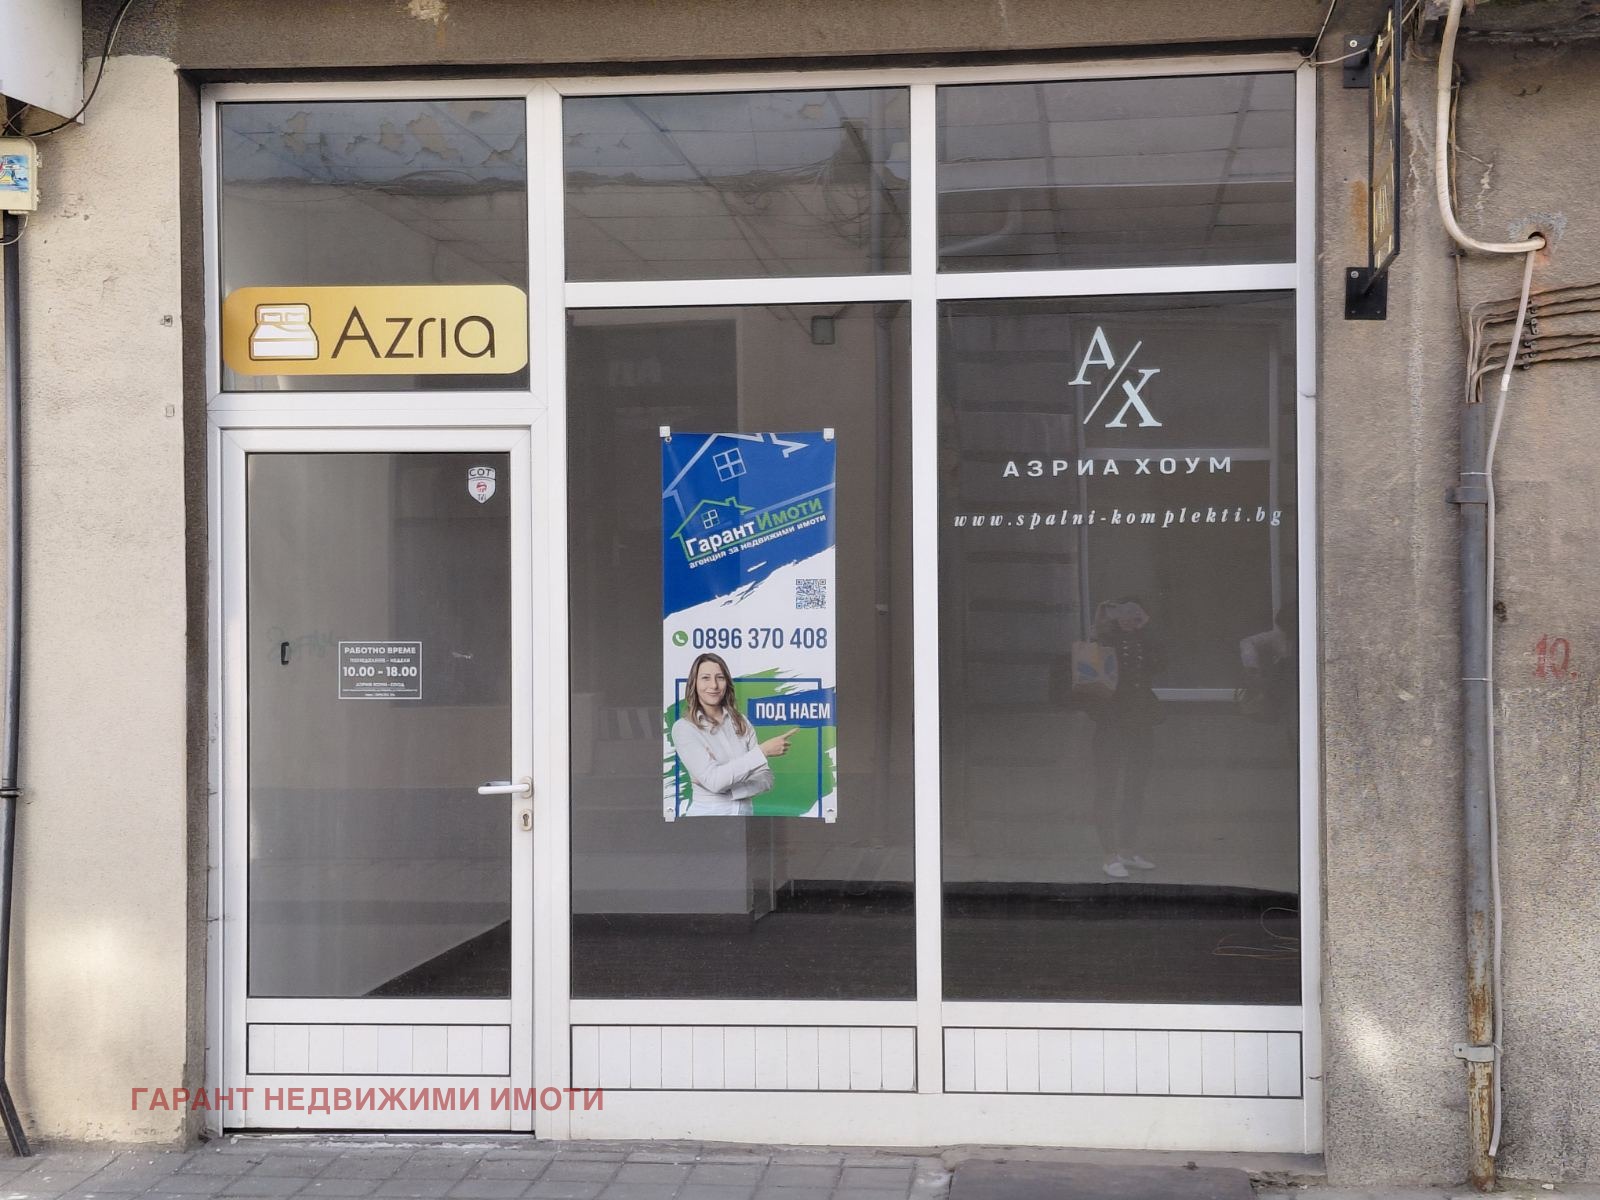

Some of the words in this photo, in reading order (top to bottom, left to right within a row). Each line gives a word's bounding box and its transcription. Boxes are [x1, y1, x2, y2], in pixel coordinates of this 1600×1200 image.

[331, 305, 496, 359] Azria
[1002, 459, 1120, 478] АЗРИА
[1134, 456, 1232, 476] ХОУМ
[685, 521, 755, 557] Гарант
[755, 497, 823, 531] Имоти
[688, 551, 727, 569] агенция
[728, 546, 739, 555] за
[740, 526, 795, 551] недвижими
[797, 514, 827, 530] имоти
[692, 628, 742, 649] 0896
[748, 628, 784, 649] 370
[789, 628, 828, 649] 408
[344, 646, 386, 654] РАБОТНО
[387, 646, 417, 654] ВРЕМЕ
[343, 666, 375, 677] 10.00
[385, 666, 418, 677] 18.00
[755, 703, 787, 721] ПОД
[790, 703, 831, 719] НАЕМ
